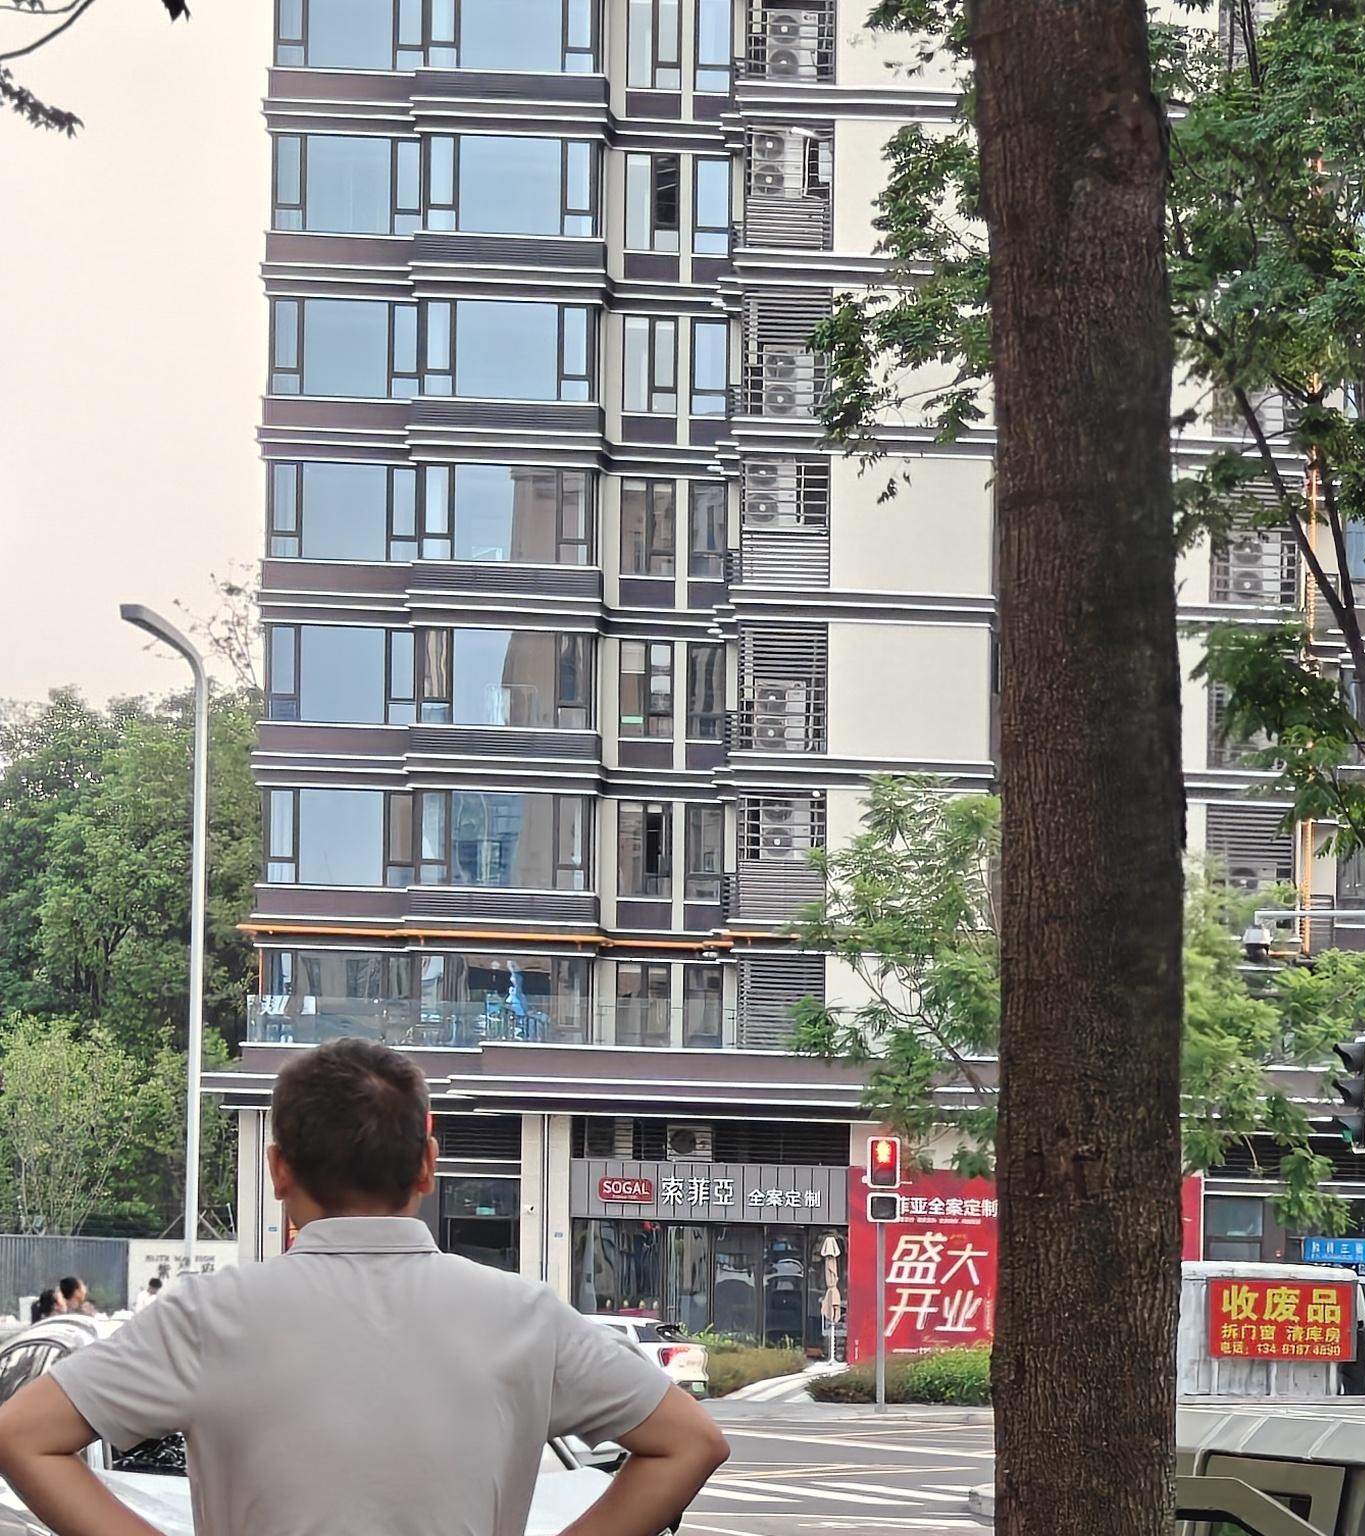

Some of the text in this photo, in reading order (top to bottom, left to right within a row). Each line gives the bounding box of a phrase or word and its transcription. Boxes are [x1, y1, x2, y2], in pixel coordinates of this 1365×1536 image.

[602, 1181, 649, 1196] SOGAL
[661, 1177, 821, 1208] 索菲亞 全案定制
[885, 1231, 989, 1286] 盛大
[884, 1287, 982, 1337] 开业
[1222, 1284, 1341, 1324] 收废品
